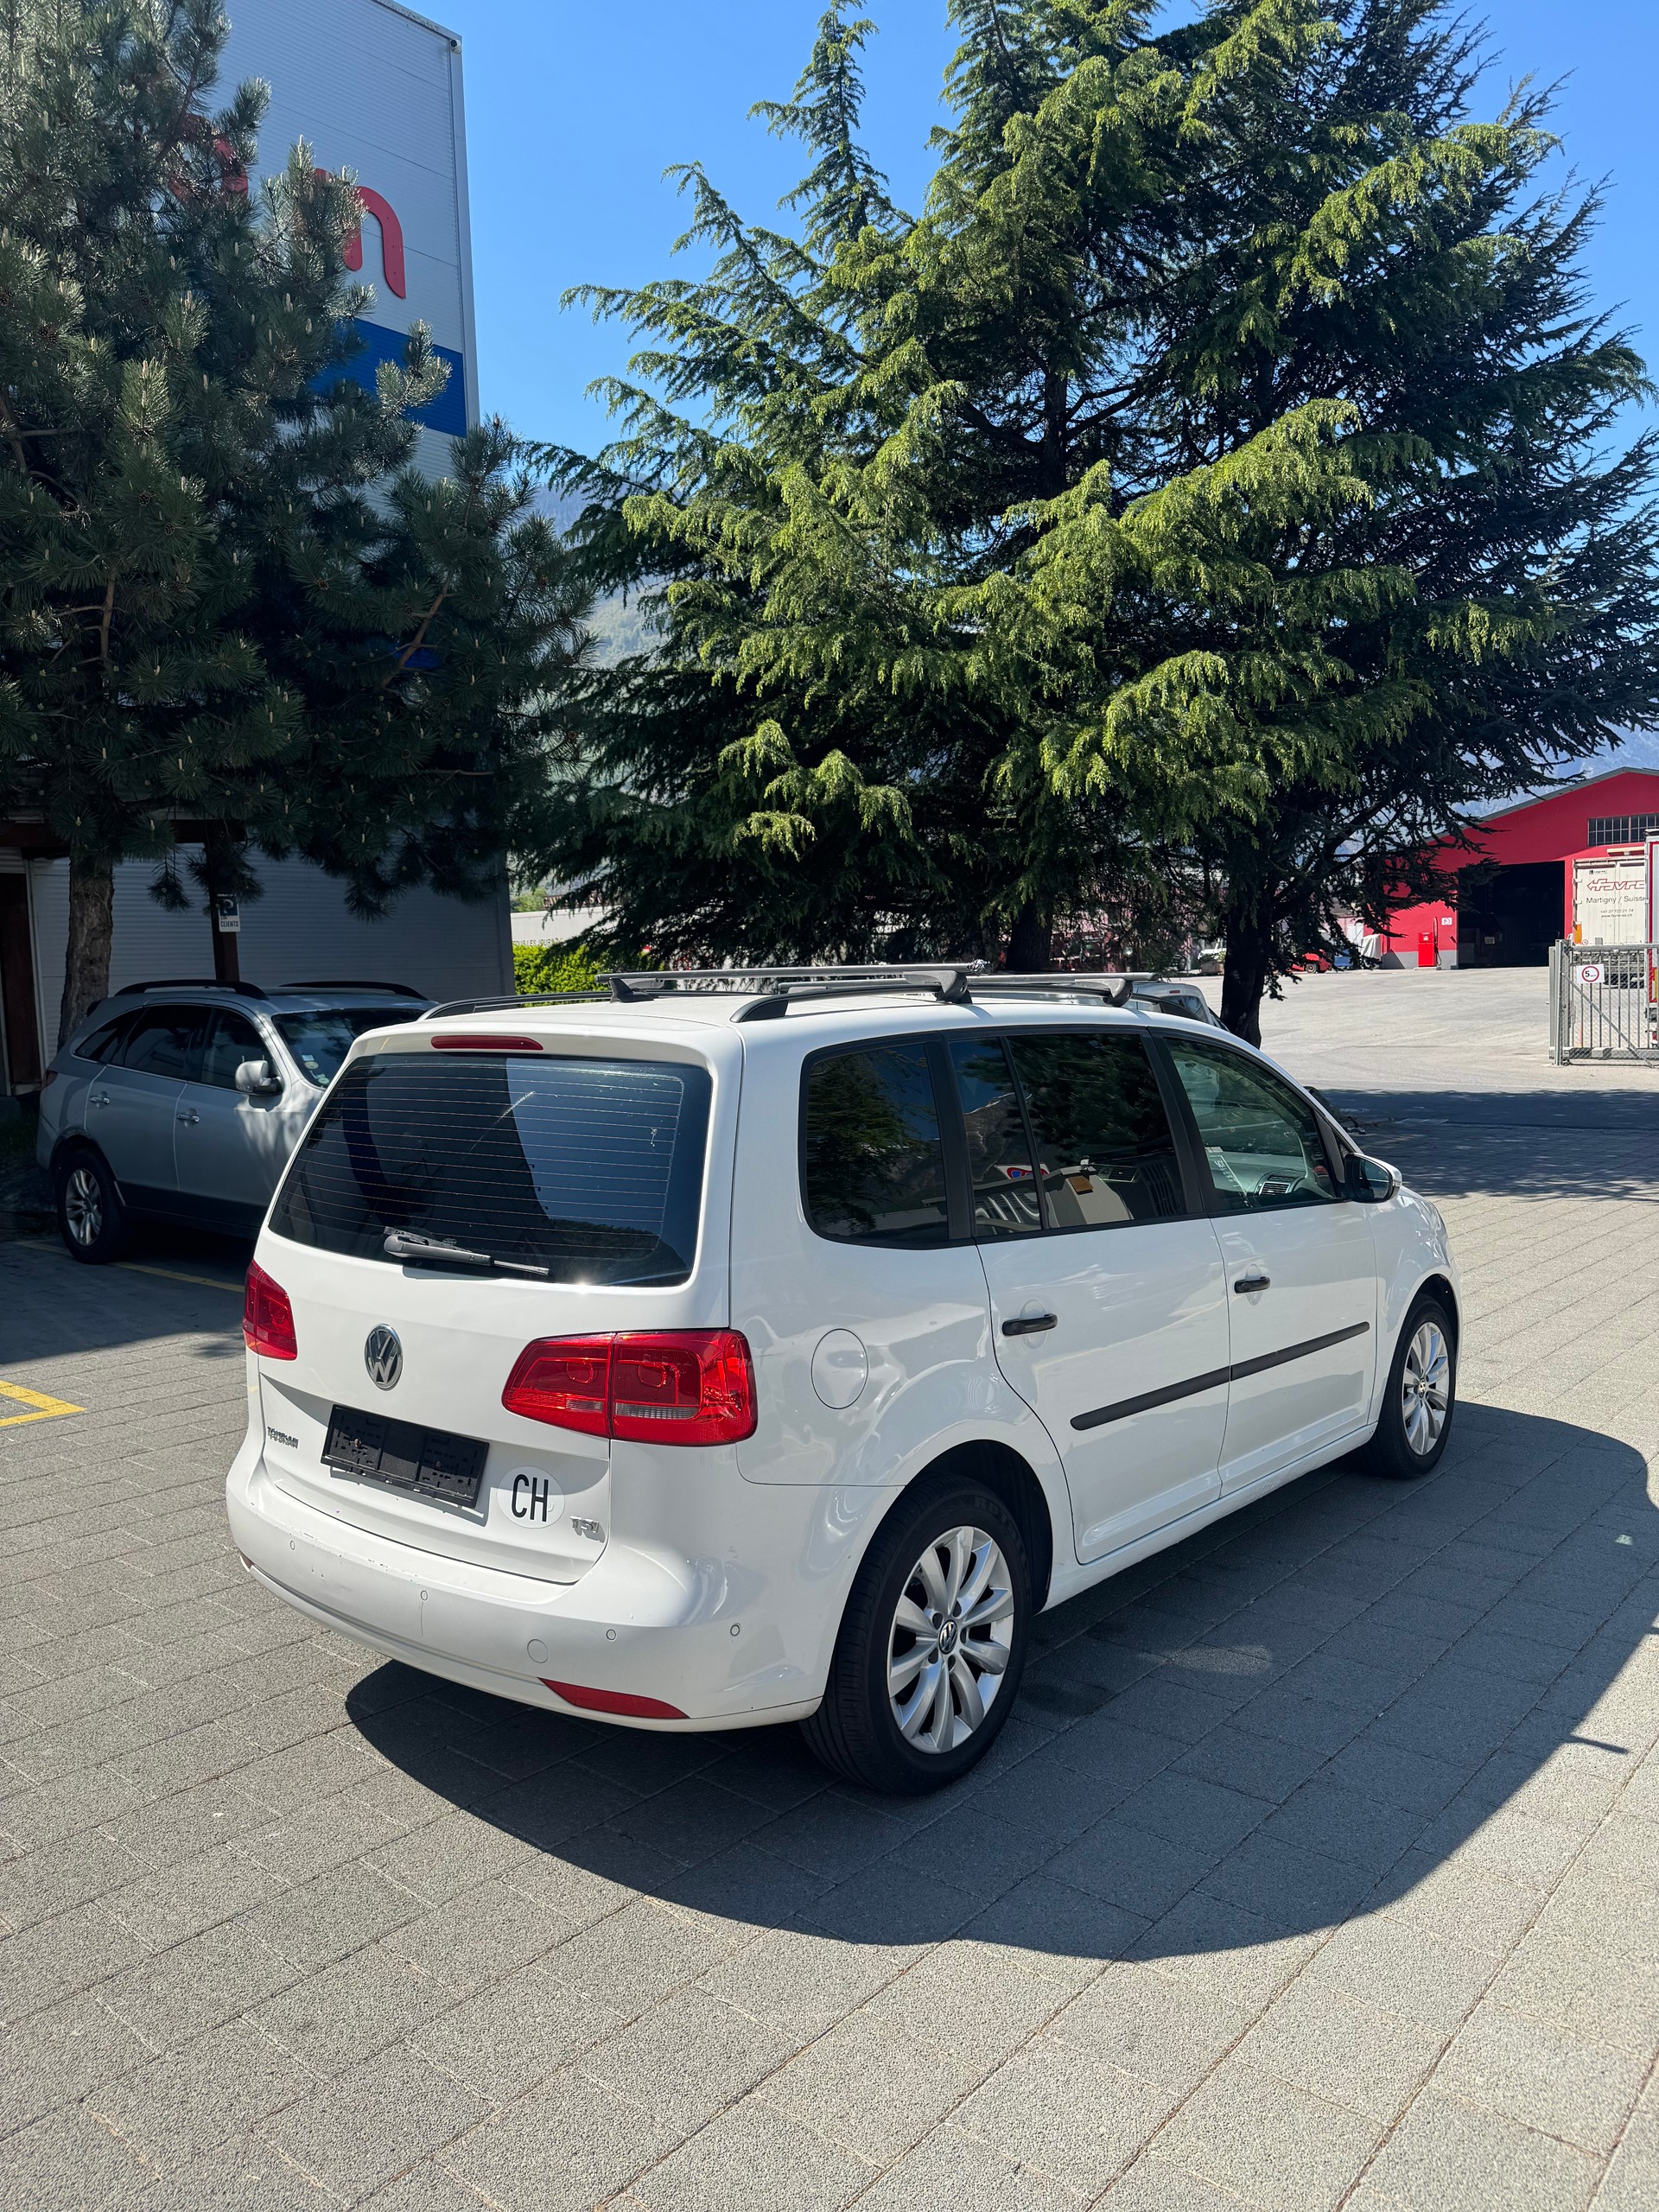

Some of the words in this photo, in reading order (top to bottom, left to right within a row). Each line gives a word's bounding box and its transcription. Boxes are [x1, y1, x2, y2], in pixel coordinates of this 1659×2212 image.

[1586, 896, 1617, 905] Martigny
[1624, 894, 1645, 903] Suiss
[512, 1473, 549, 1522] CH
[569, 1515, 600, 1534] TSI
